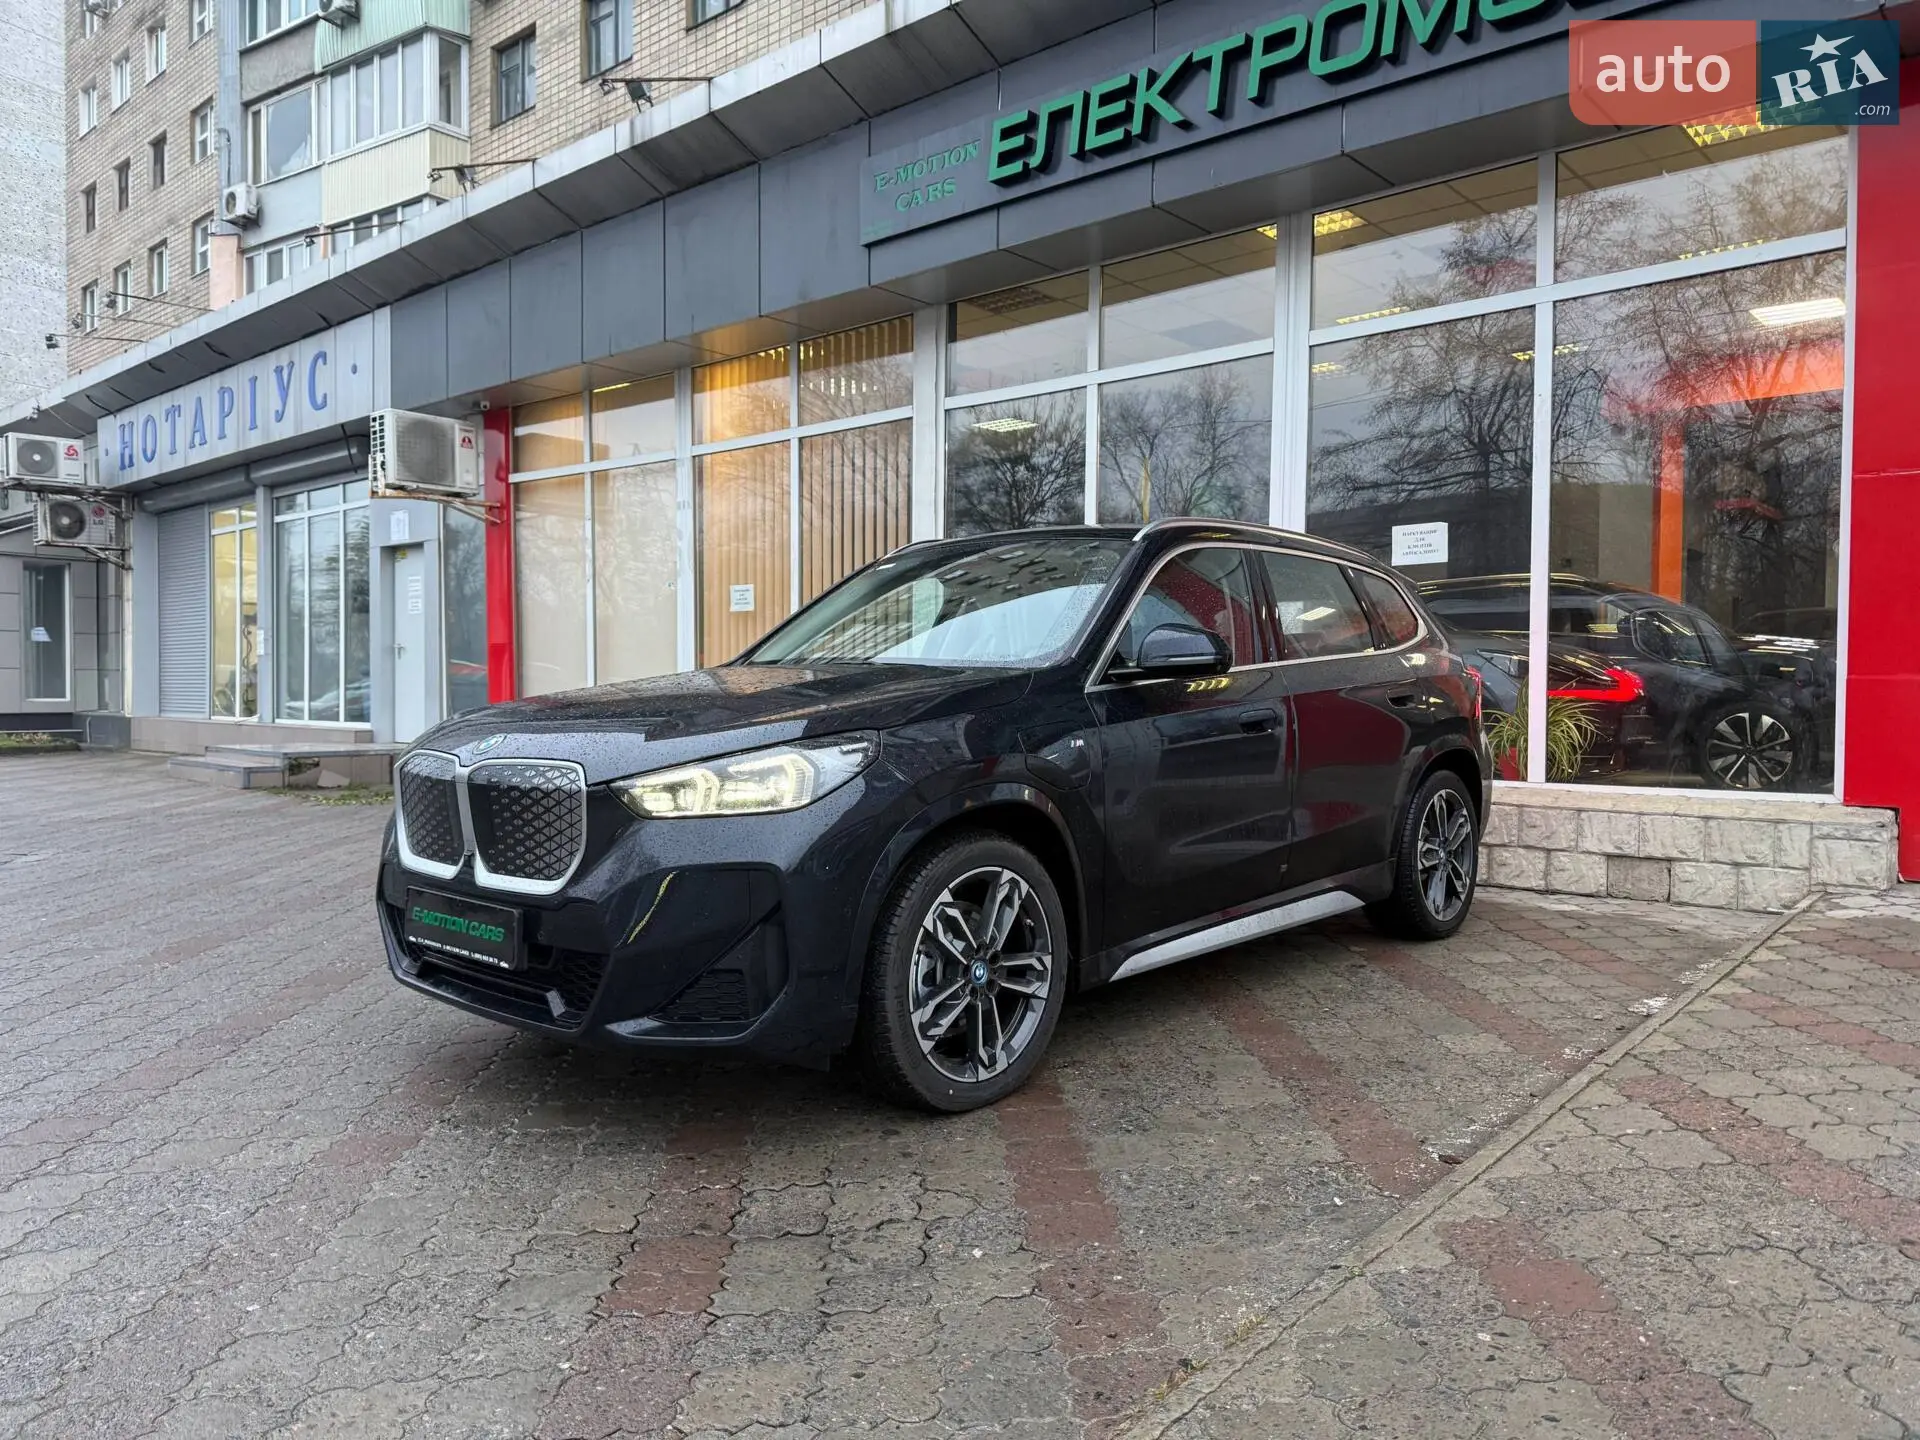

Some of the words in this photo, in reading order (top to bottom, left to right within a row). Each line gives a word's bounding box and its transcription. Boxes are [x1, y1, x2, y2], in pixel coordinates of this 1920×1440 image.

[988, 0, 1546, 184] ЕЛЕКТРОМ
[873, 138, 981, 193] E-MOTION
[894, 176, 957, 213] CARS
[118, 350, 328, 471] НОТАРІУС
[412, 906, 468, 933] E-MOTION
[469, 921, 505, 942] CARS
